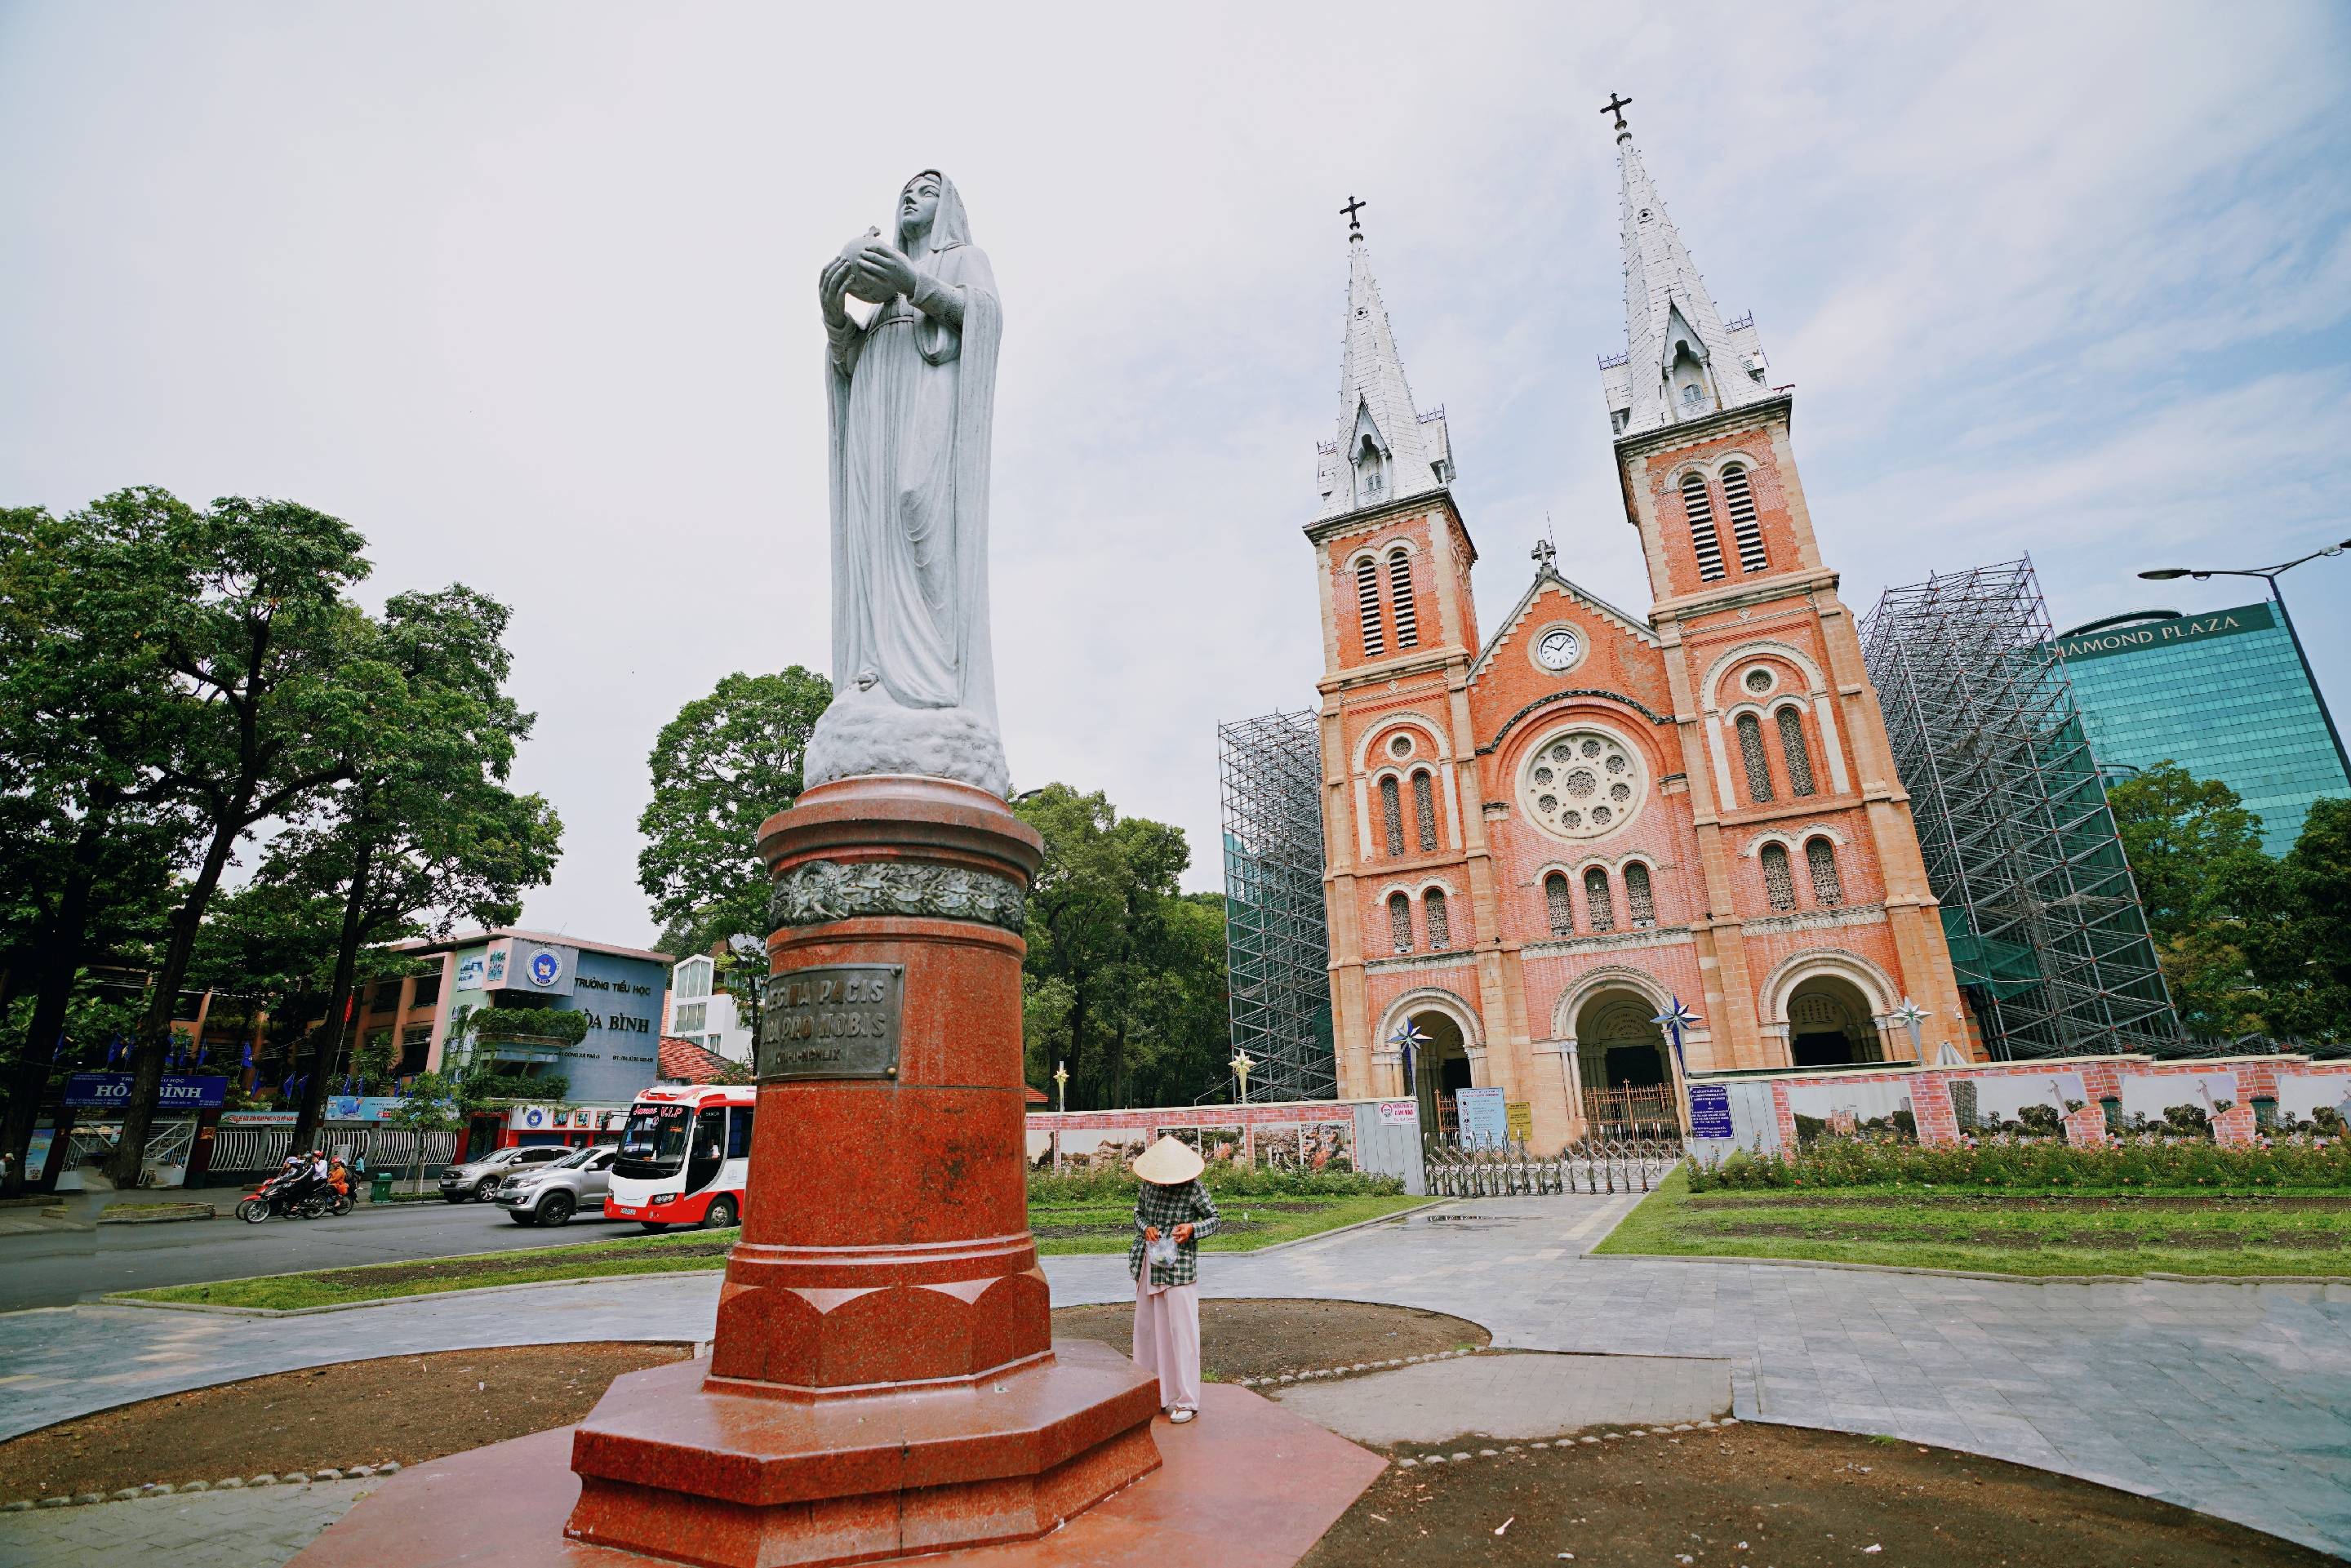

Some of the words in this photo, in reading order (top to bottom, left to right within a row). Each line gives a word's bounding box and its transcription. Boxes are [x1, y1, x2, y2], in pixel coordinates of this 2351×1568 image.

[2161, 616, 2239, 639] PLAZA
[575, 977, 609, 991] TRƯỜNG
[612, 980, 630, 993] TIỂU
[633, 985, 651, 996] HỌC
[817, 979, 885, 1004] PACIS
[608, 1012, 650, 1033] BÌNH
[781, 1015, 814, 1042] PRO
[819, 1012, 886, 1037] NOBIS
